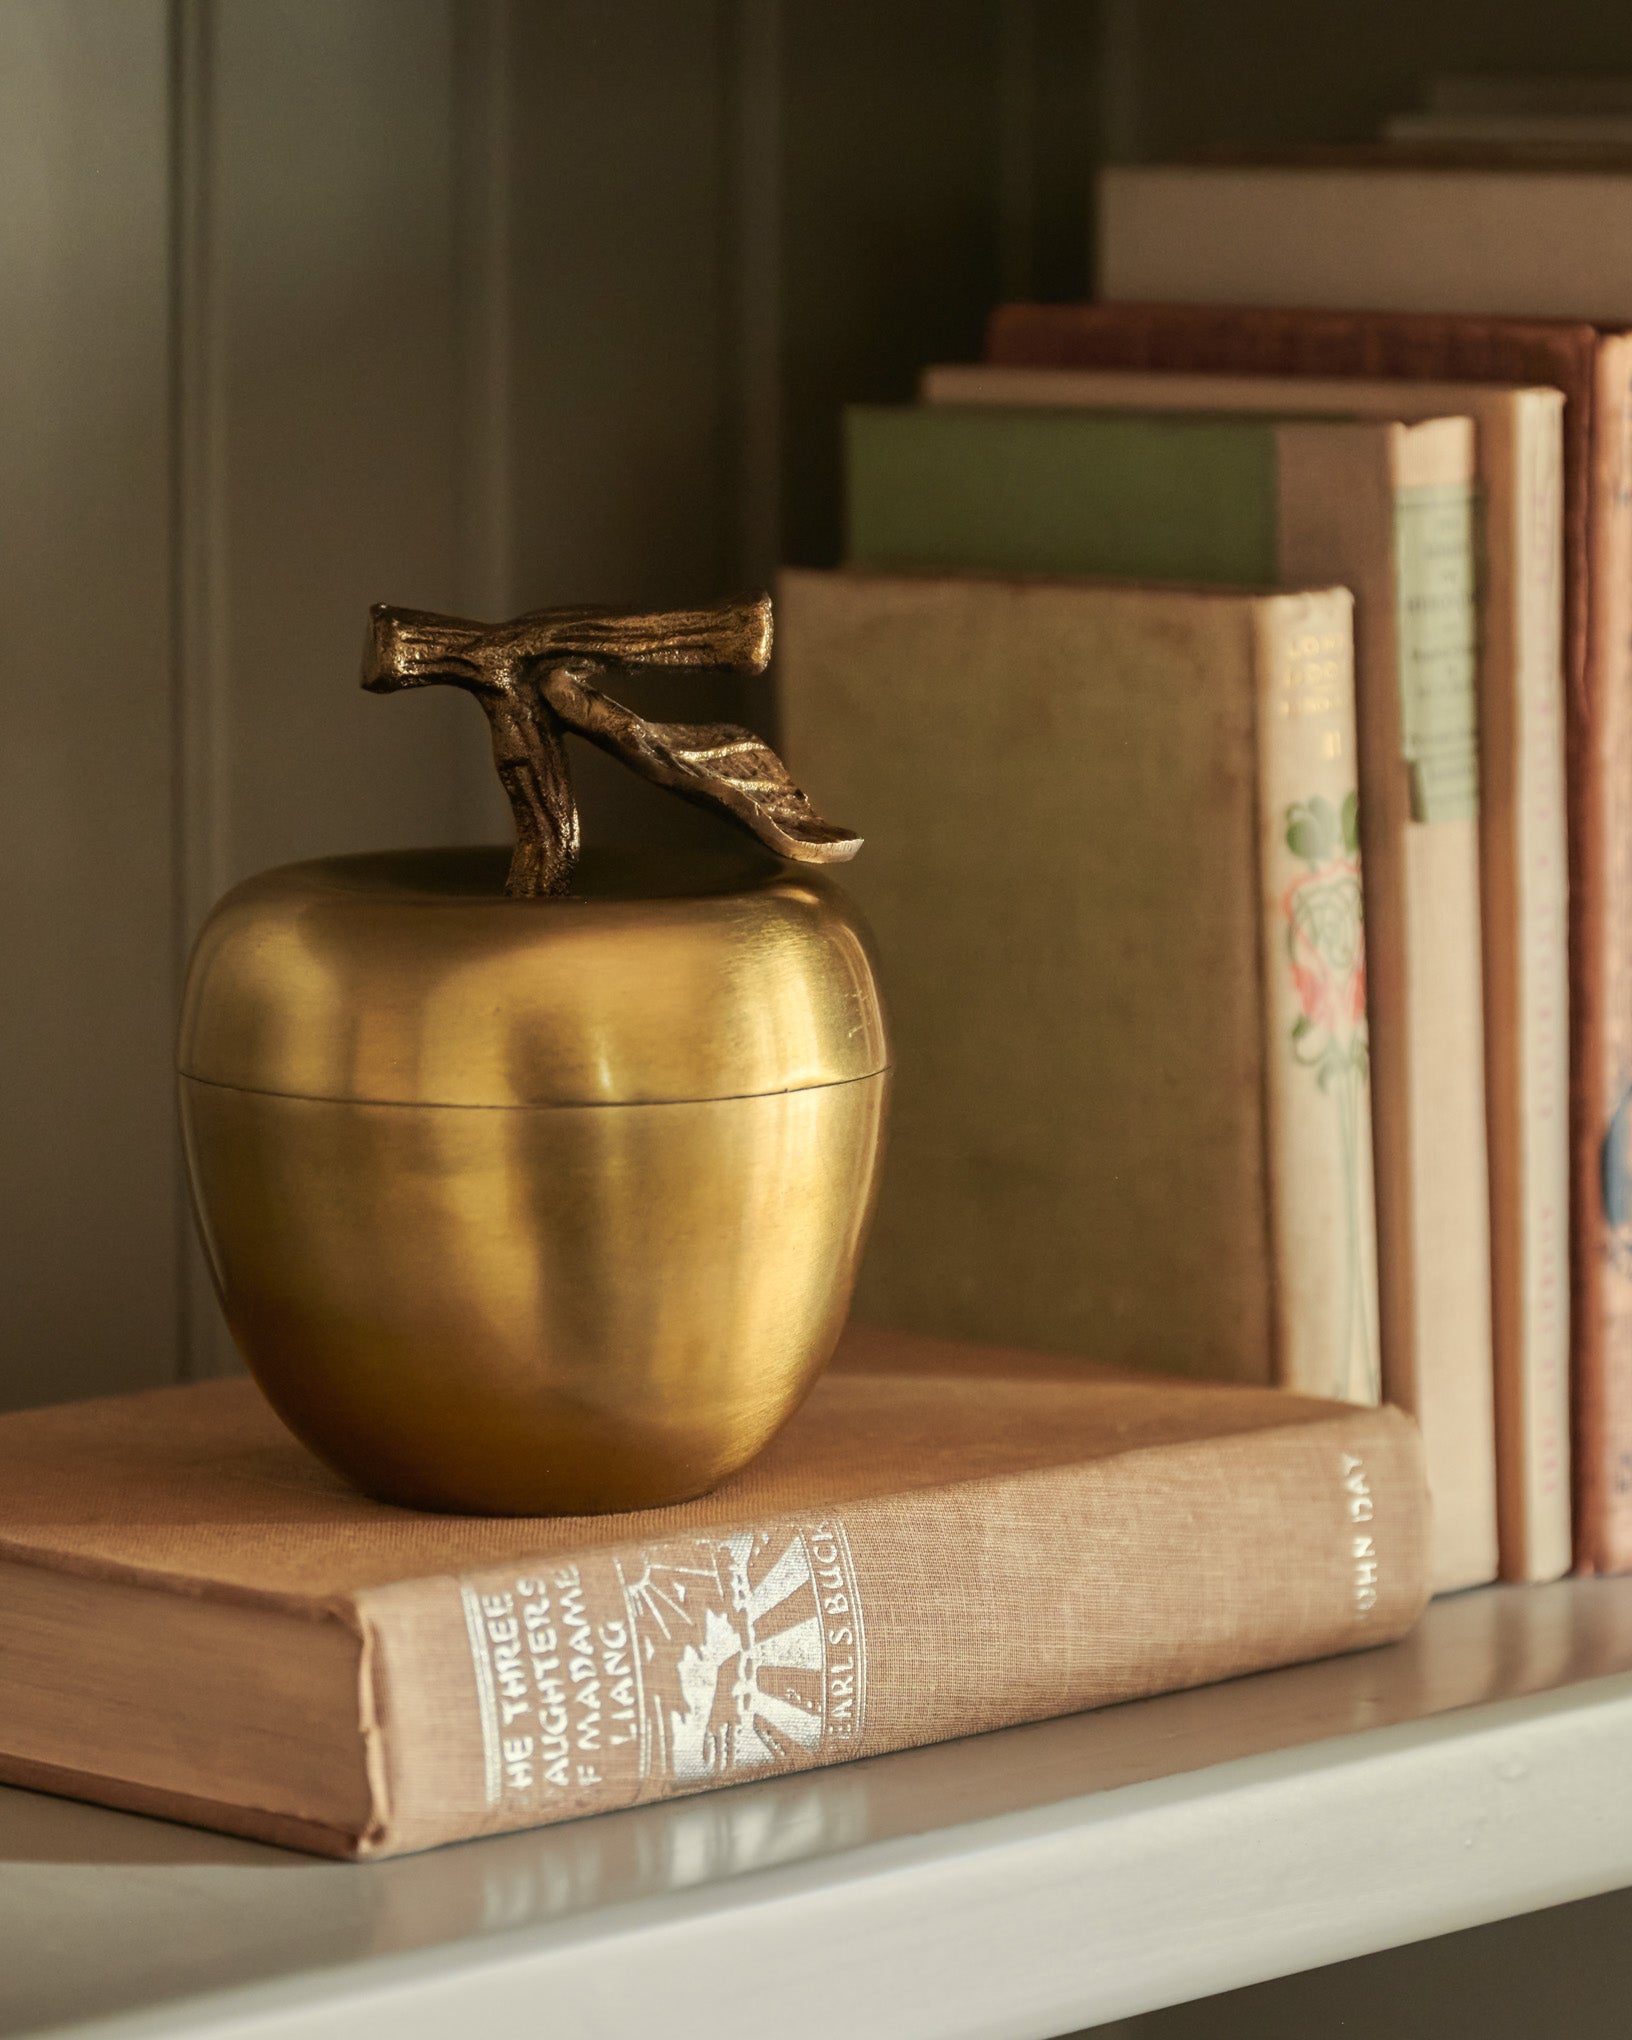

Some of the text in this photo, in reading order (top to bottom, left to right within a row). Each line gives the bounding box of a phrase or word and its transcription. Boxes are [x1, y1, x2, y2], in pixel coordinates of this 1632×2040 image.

[1341, 1453, 1378, 1620] OHN DAY
[481, 1592, 534, 1798] HE THREE
[516, 1575, 570, 1796] AUGHTERS
[553, 1563, 602, 1750] MADAME
[598, 1619, 638, 1746] LIANG
[828, 1655, 855, 1741] EARL
